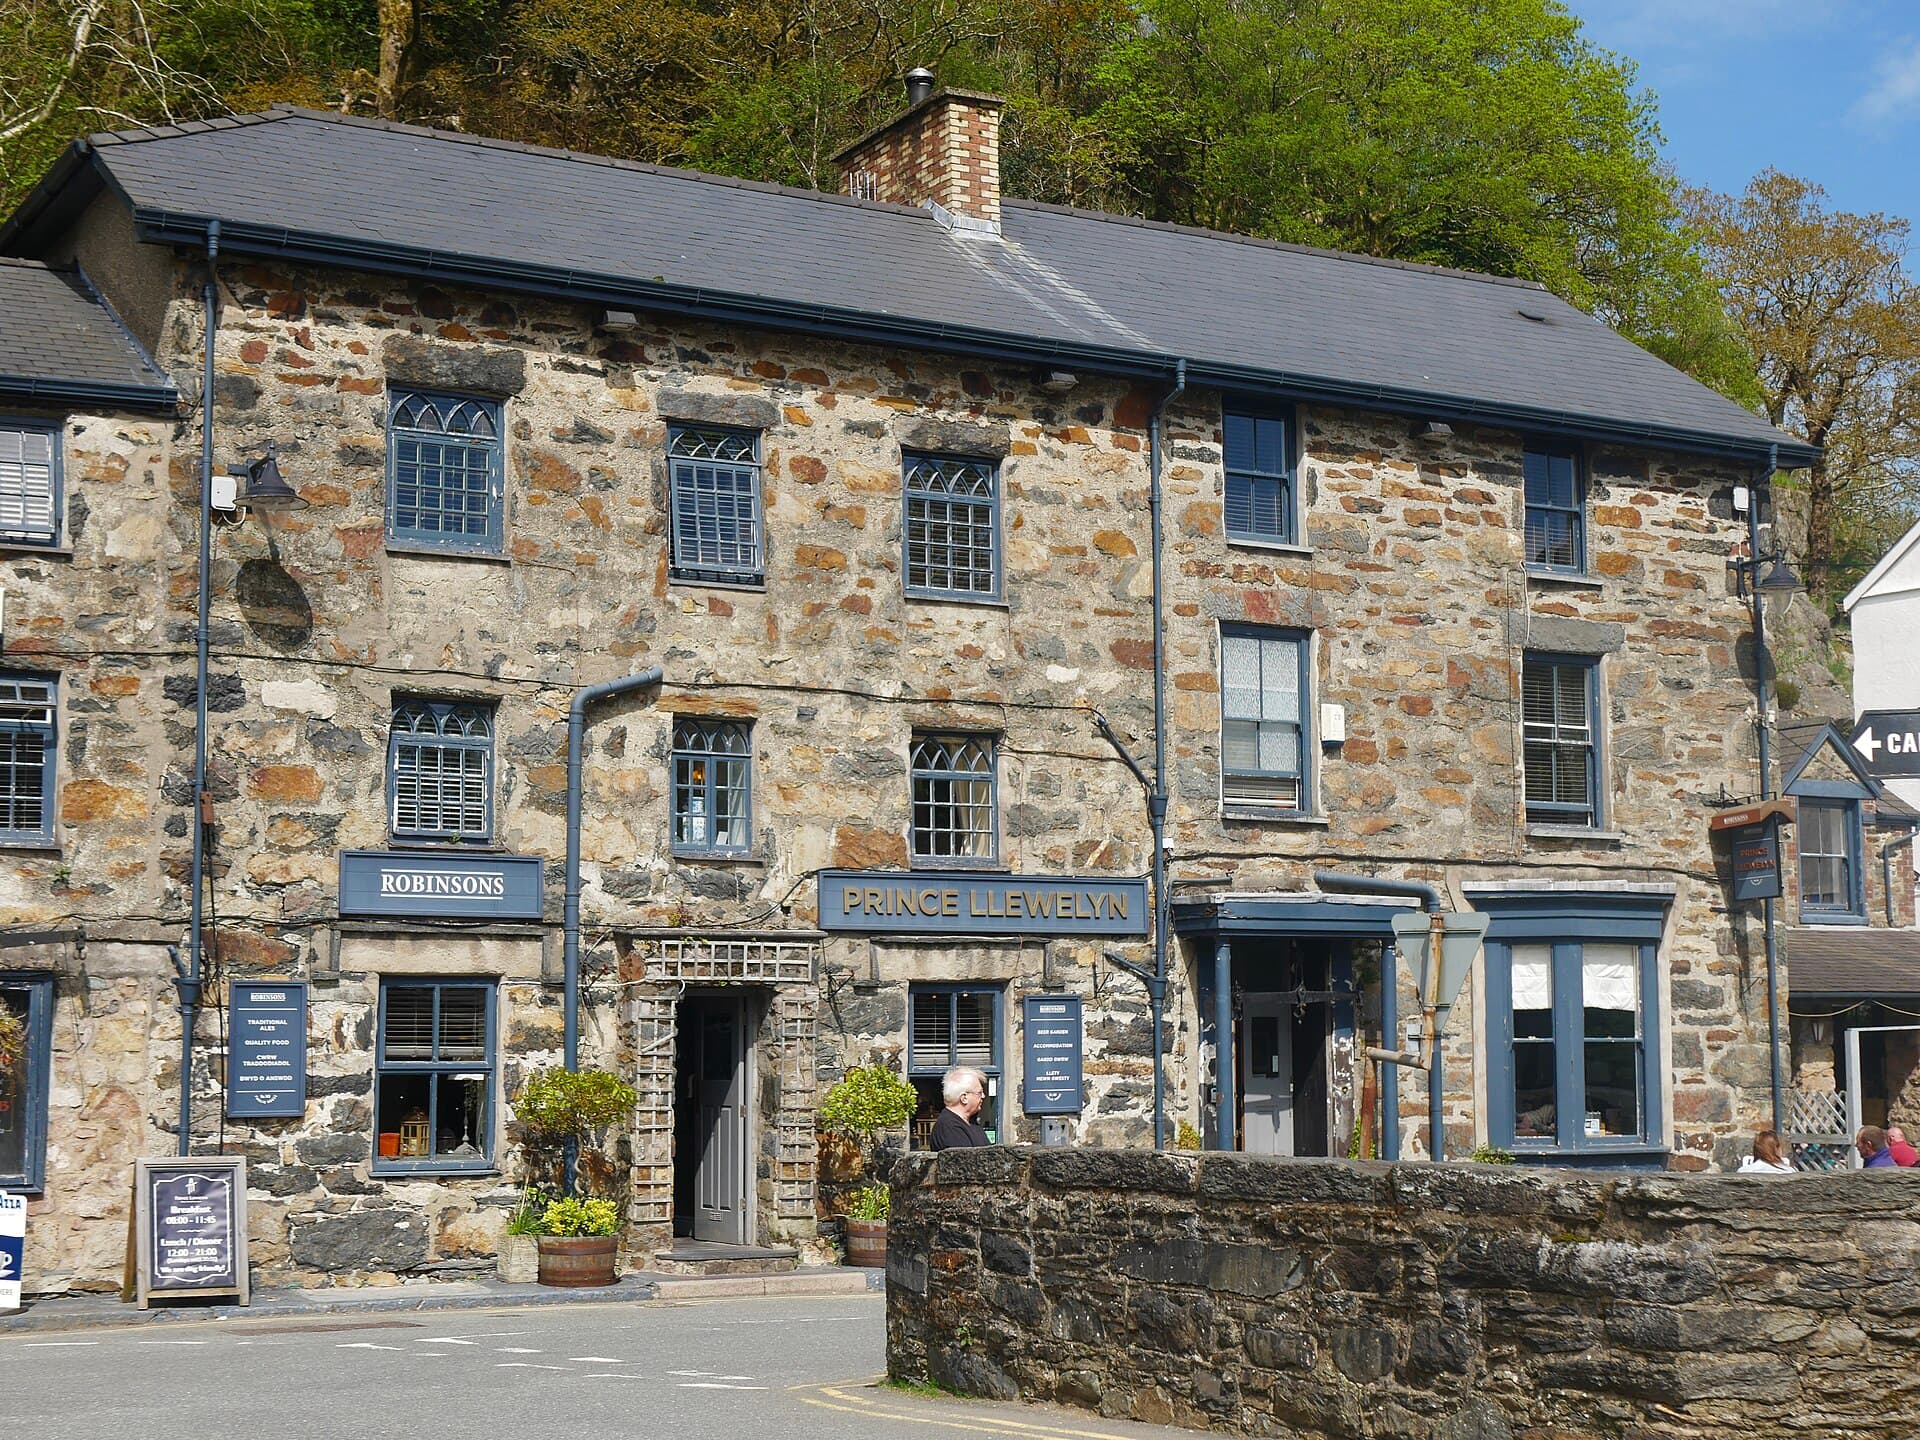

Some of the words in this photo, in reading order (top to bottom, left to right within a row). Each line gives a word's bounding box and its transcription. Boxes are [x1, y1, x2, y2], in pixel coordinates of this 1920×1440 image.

[1887, 732, 1920, 754] CA
[381, 874, 504, 896] ROBINSONS
[843, 887, 960, 917] PRINCE
[969, 890, 1128, 920] LLEWELYN
[170, 1206, 212, 1214] Breakfast
[161, 1238, 187, 1246] Lunch
